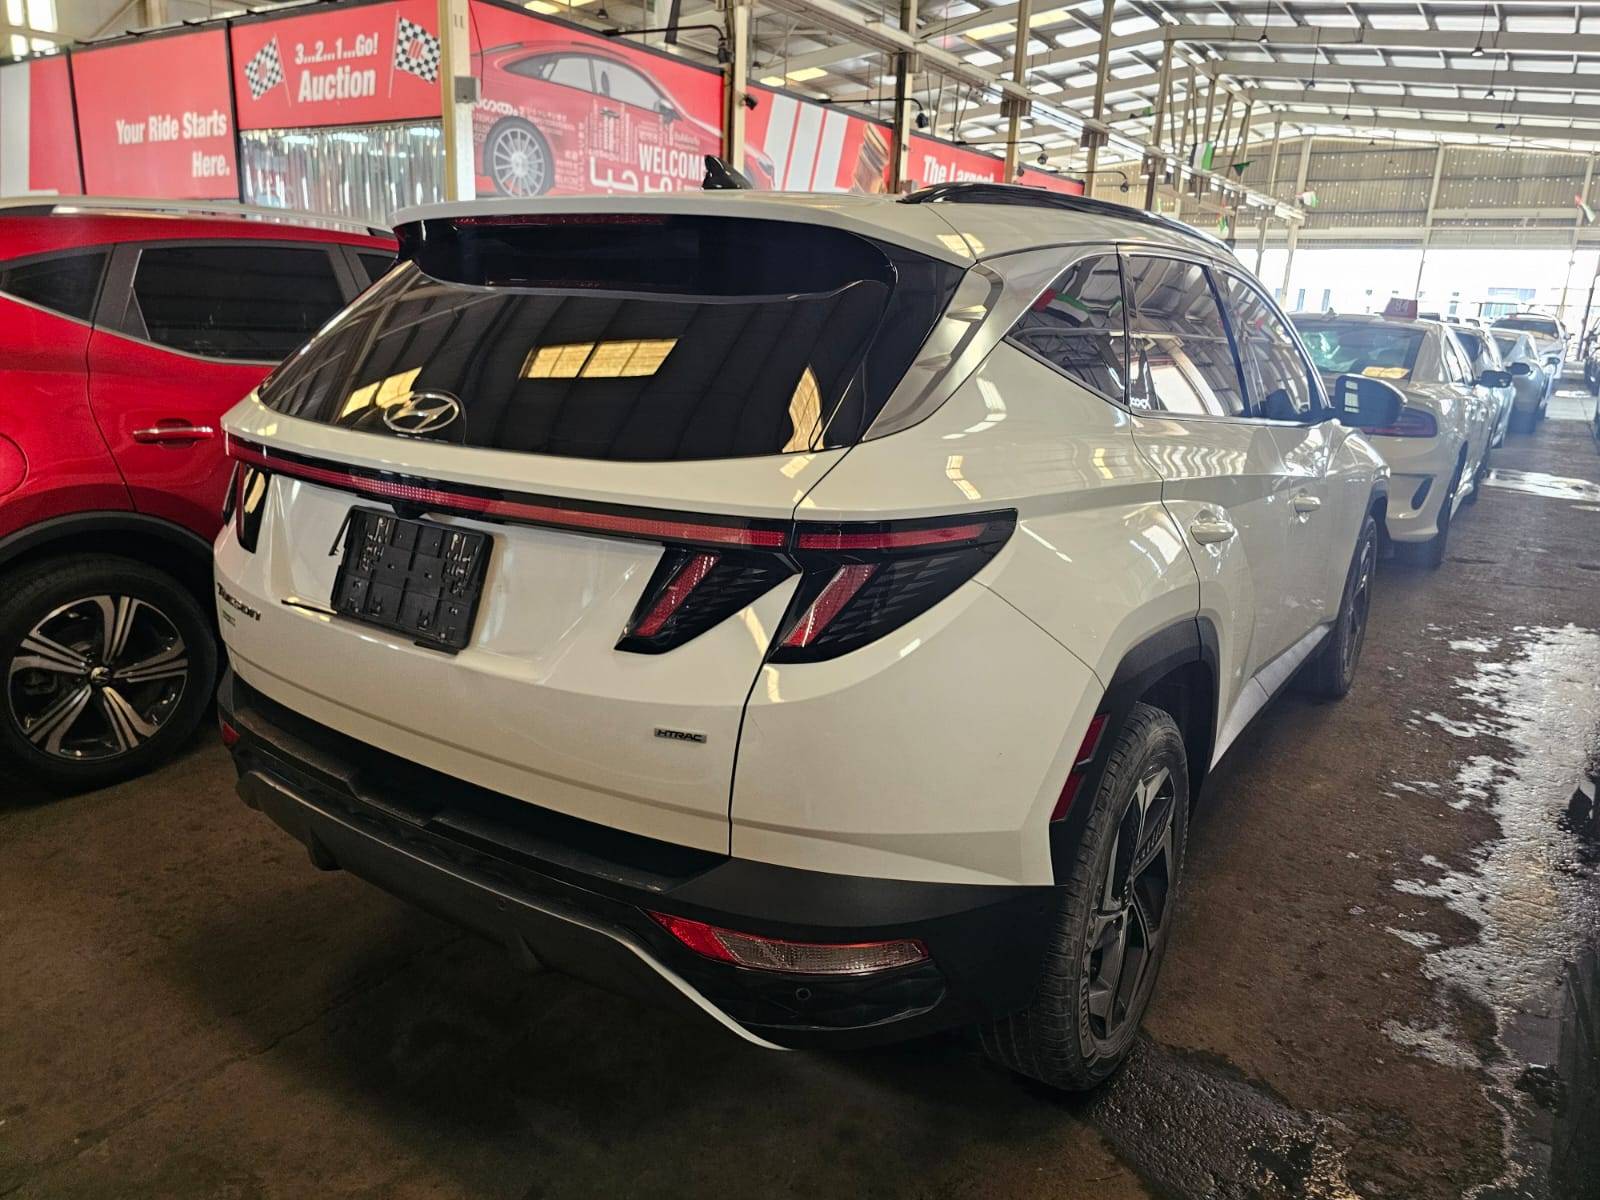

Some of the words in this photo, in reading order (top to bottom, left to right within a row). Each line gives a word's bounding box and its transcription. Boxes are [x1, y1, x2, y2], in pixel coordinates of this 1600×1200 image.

[295, 32, 378, 65] 3...2...1...Go!
[298, 65, 376, 102] Auction
[116, 118, 145, 145] Your
[148, 114, 179, 142] Ride
[183, 109, 227, 139] Starts
[192, 150, 230, 178] Here.
[923, 154, 947, 185] The
[656, 728, 704, 743] HTRAC
